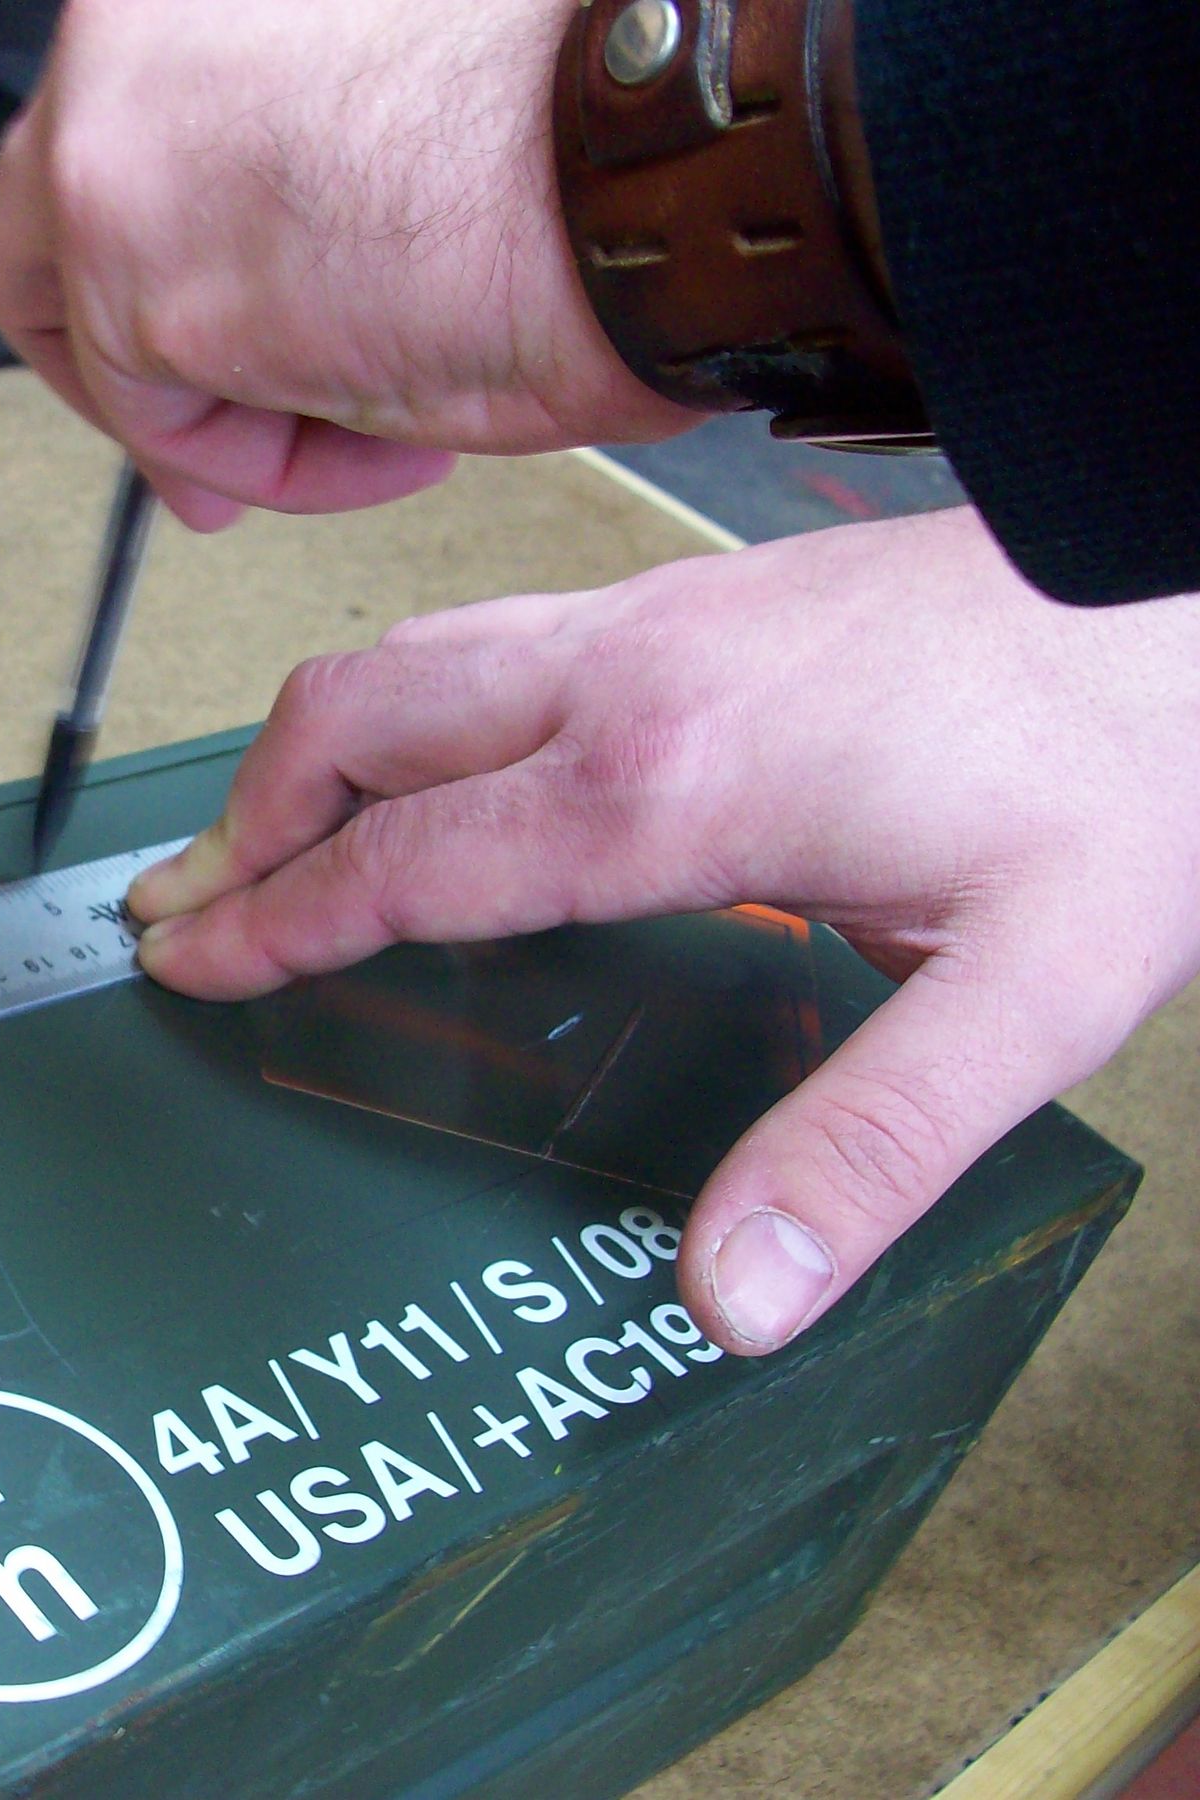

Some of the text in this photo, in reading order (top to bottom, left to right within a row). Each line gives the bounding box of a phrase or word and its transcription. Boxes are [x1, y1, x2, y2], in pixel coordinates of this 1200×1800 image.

[43, 901, 63, 917] 5
[69, 943, 100, 961] 18
[22, 955, 55, 975] 19
